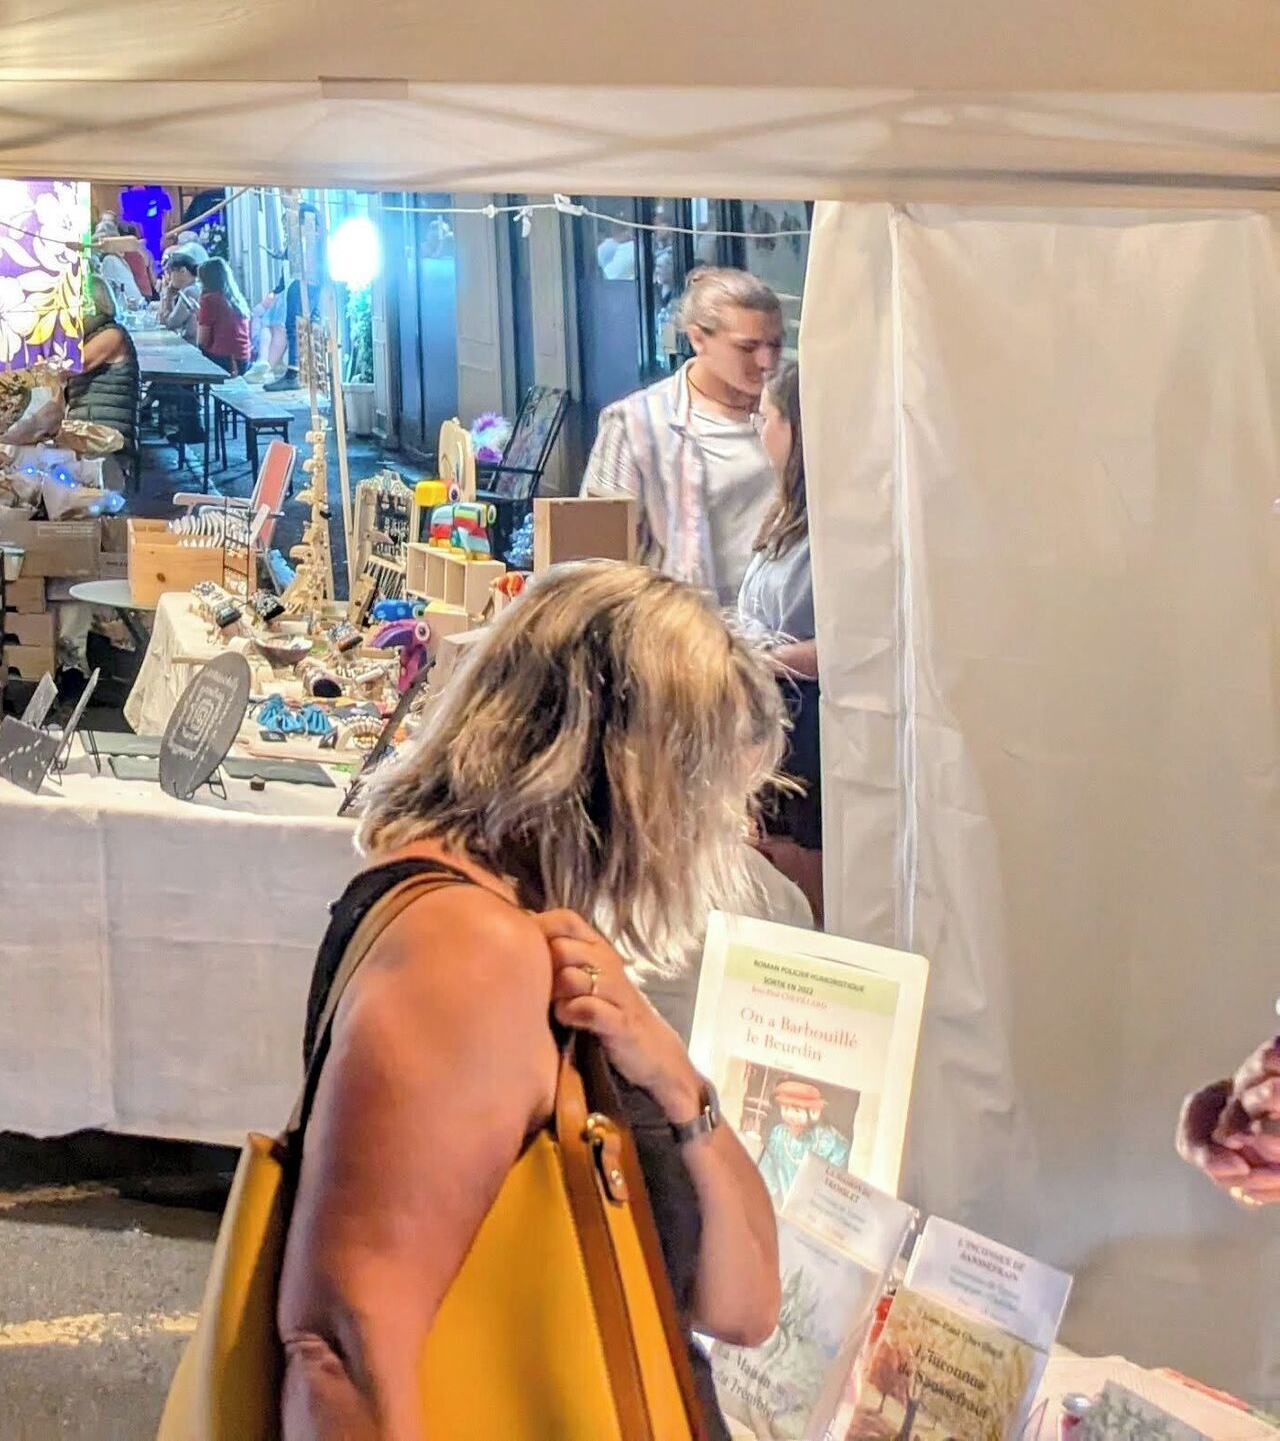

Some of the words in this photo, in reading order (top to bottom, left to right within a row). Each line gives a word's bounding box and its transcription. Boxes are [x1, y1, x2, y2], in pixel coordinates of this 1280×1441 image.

[753, 959, 780, 972] ROMAN
[781, 965, 810, 980] POLICIER
[810, 972, 865, 992] HUMORISTIQUE
[763, 976, 786, 990] SORTIE
[787, 982, 796, 992] EN
[740, 1006, 764, 1025] On
[768, 1015, 776, 1028] a
[781, 1015, 859, 1049] Barbouillé
[746, 1029, 760, 1044] le
[764, 1033, 823, 1062] Beurdin
